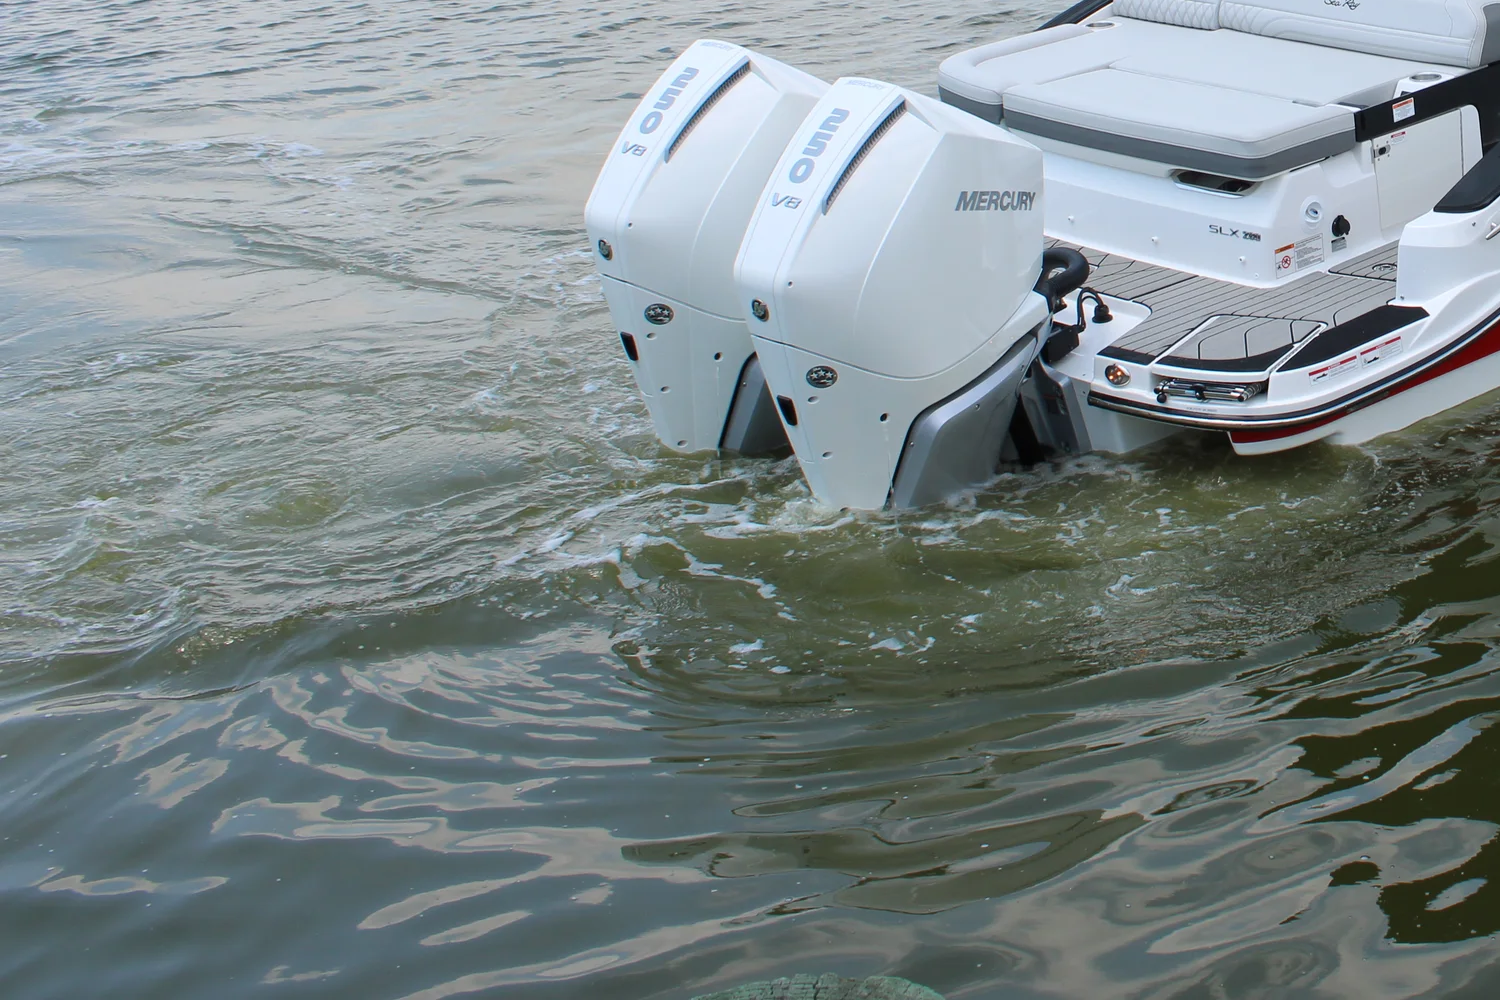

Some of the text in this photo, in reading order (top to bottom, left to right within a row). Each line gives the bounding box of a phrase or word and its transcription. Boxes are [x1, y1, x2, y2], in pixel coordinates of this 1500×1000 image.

[640, 66, 700, 135] 250
[621, 140, 648, 157] V8
[788, 107, 850, 184] 250
[771, 192, 802, 210] V8
[954, 190, 1036, 212] MERCURY
[1209, 225, 1239, 238] SLX
